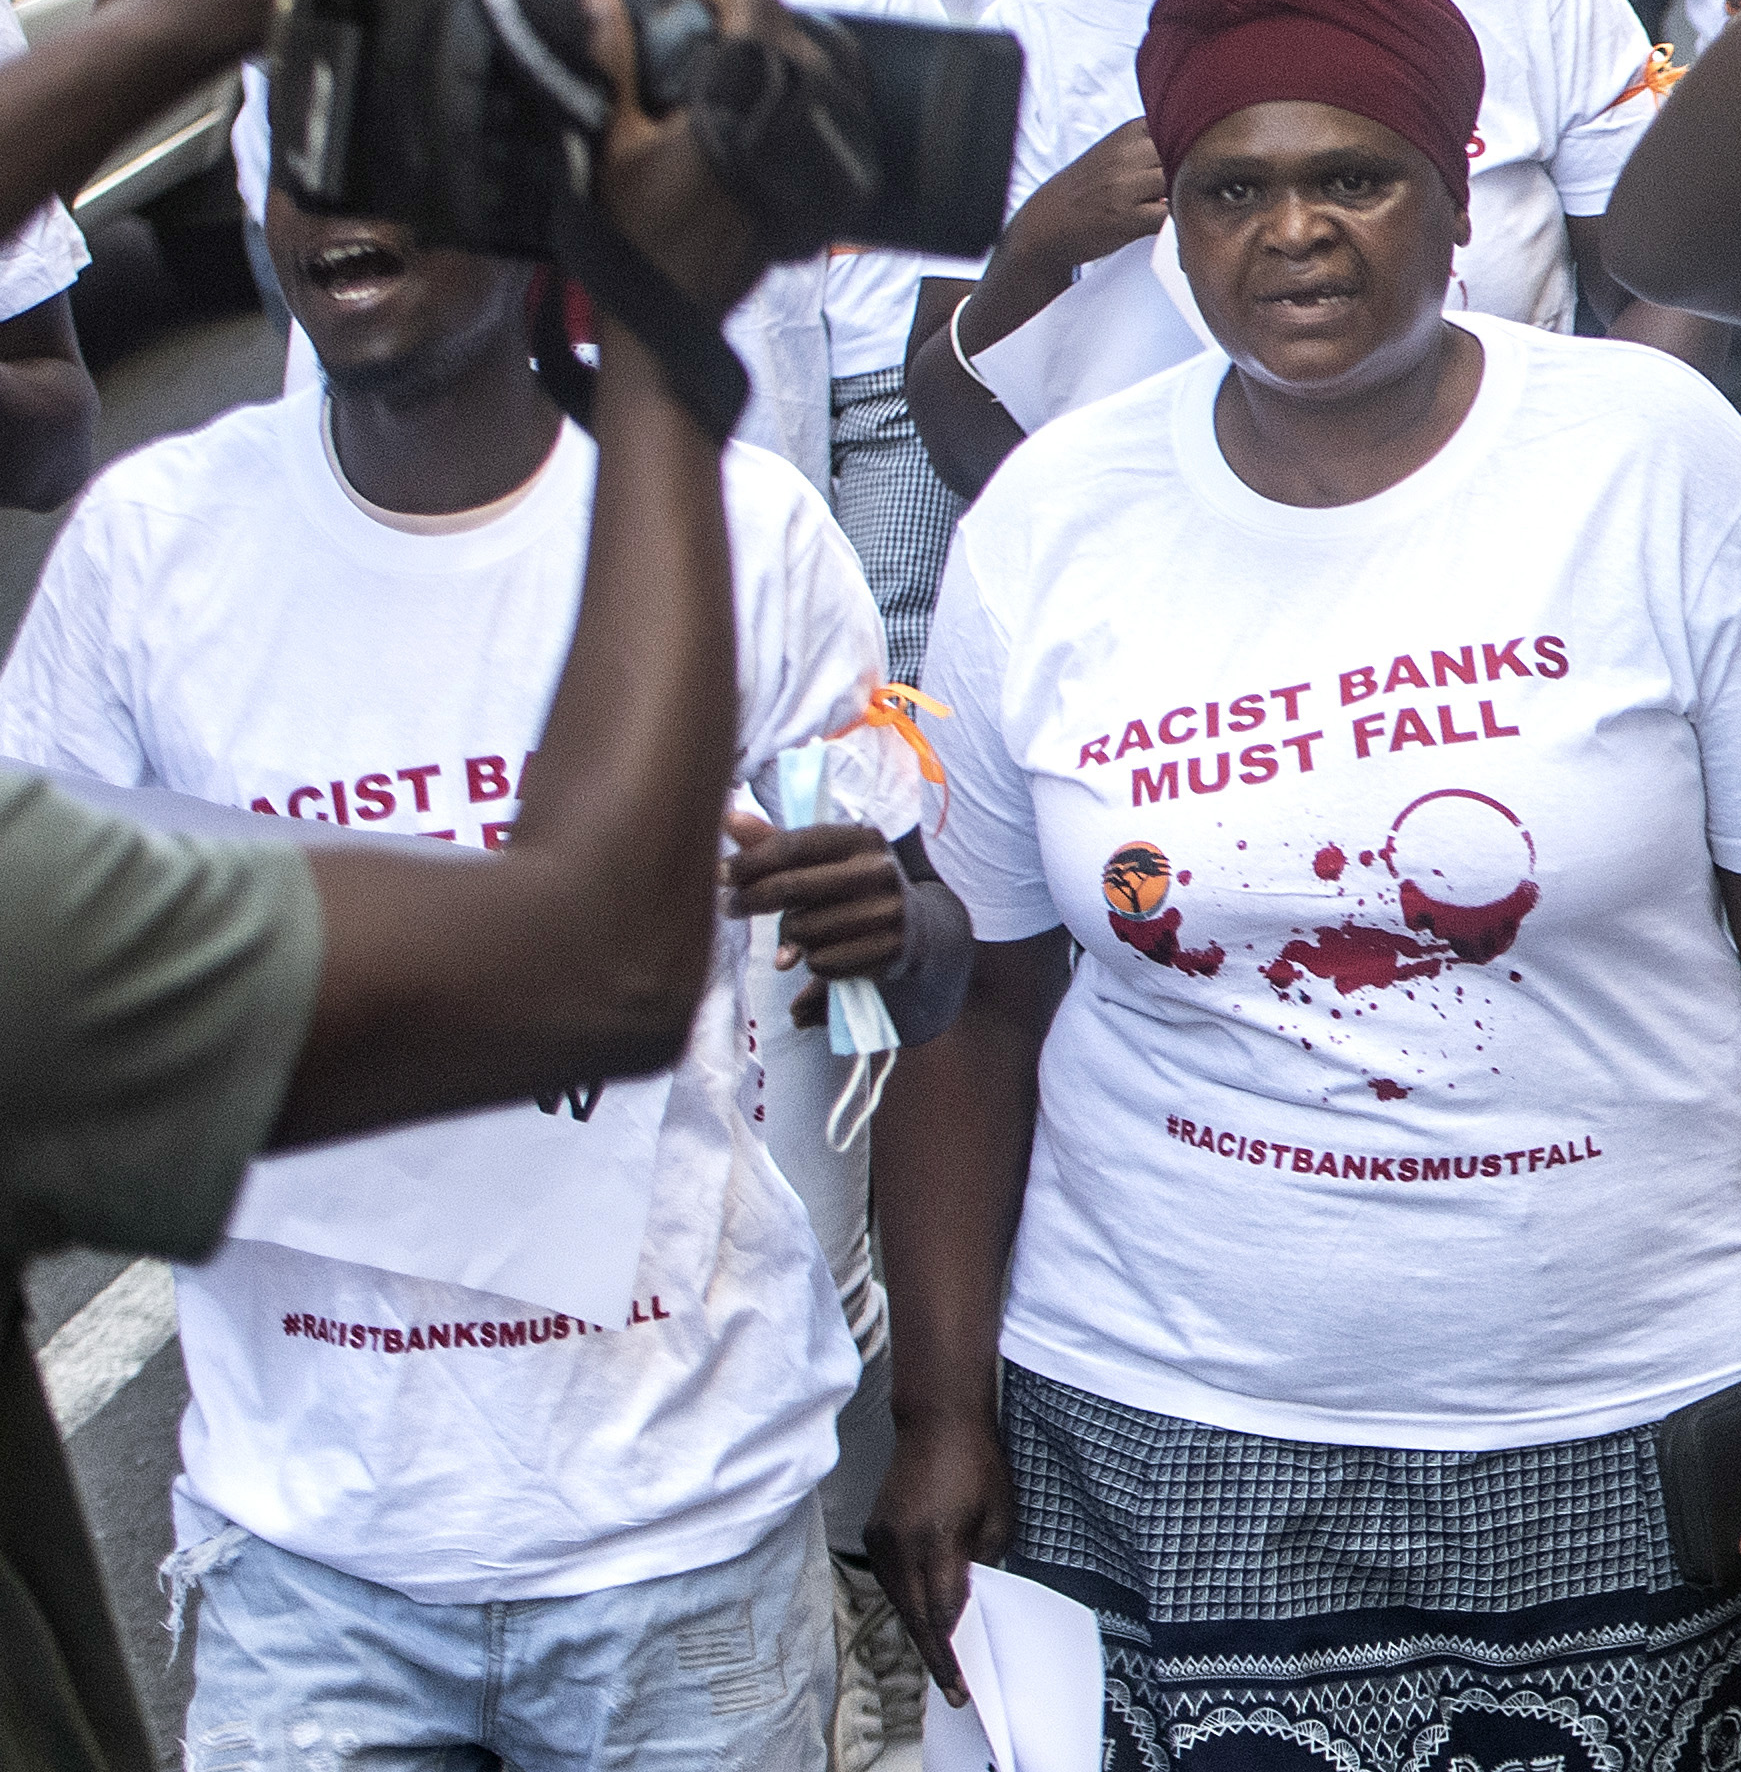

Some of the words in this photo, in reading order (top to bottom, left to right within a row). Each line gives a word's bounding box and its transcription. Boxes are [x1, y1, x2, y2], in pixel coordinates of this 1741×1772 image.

[1074, 681, 1312, 770] RACIST
[1339, 634, 1571, 708] BANKS
[248, 763, 443, 826] CIST
[1130, 730, 1325, 808] MUST
[1352, 699, 1522, 760] FALL
[1165, 1112, 1603, 1183] #RACISTBANKSMUSTFALL
